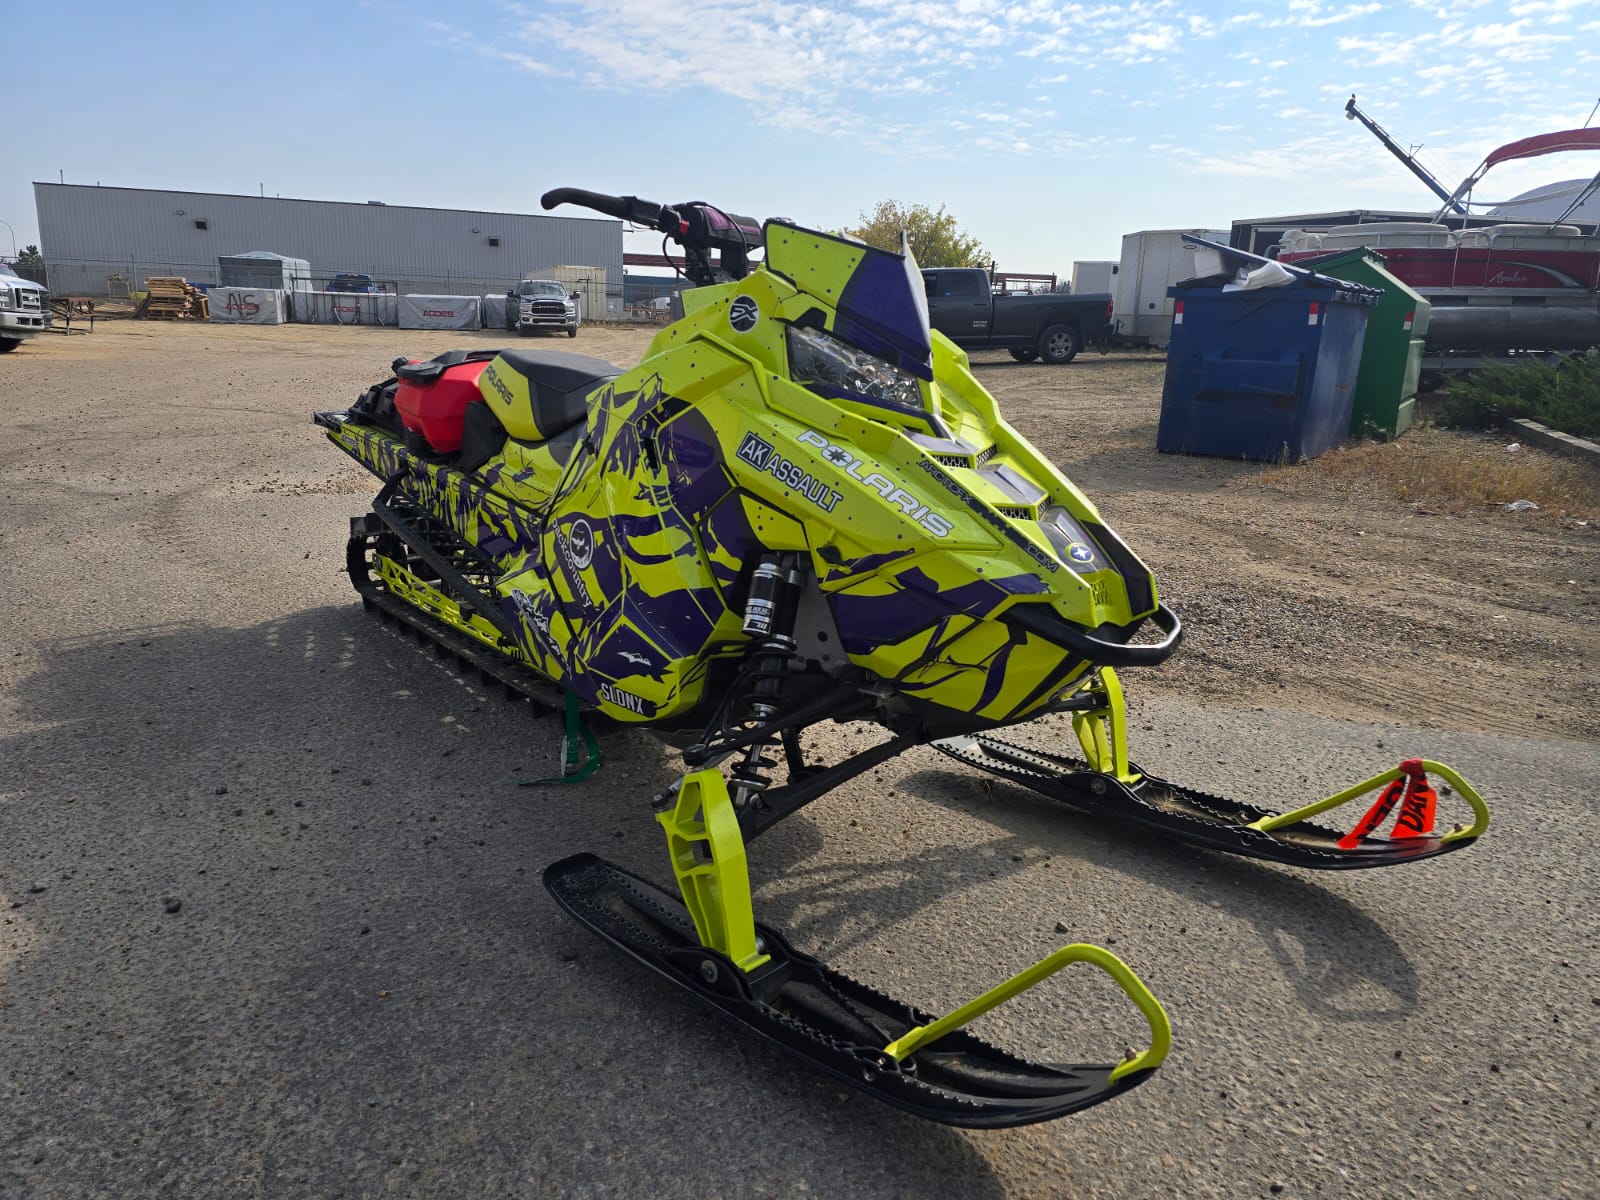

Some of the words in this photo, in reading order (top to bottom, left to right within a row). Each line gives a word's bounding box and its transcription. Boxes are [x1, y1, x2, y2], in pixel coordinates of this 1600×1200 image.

[486, 364, 515, 407] POLARIS
[763, 455, 843, 513] ASSAULT
[796, 429, 955, 538] POLARIS
